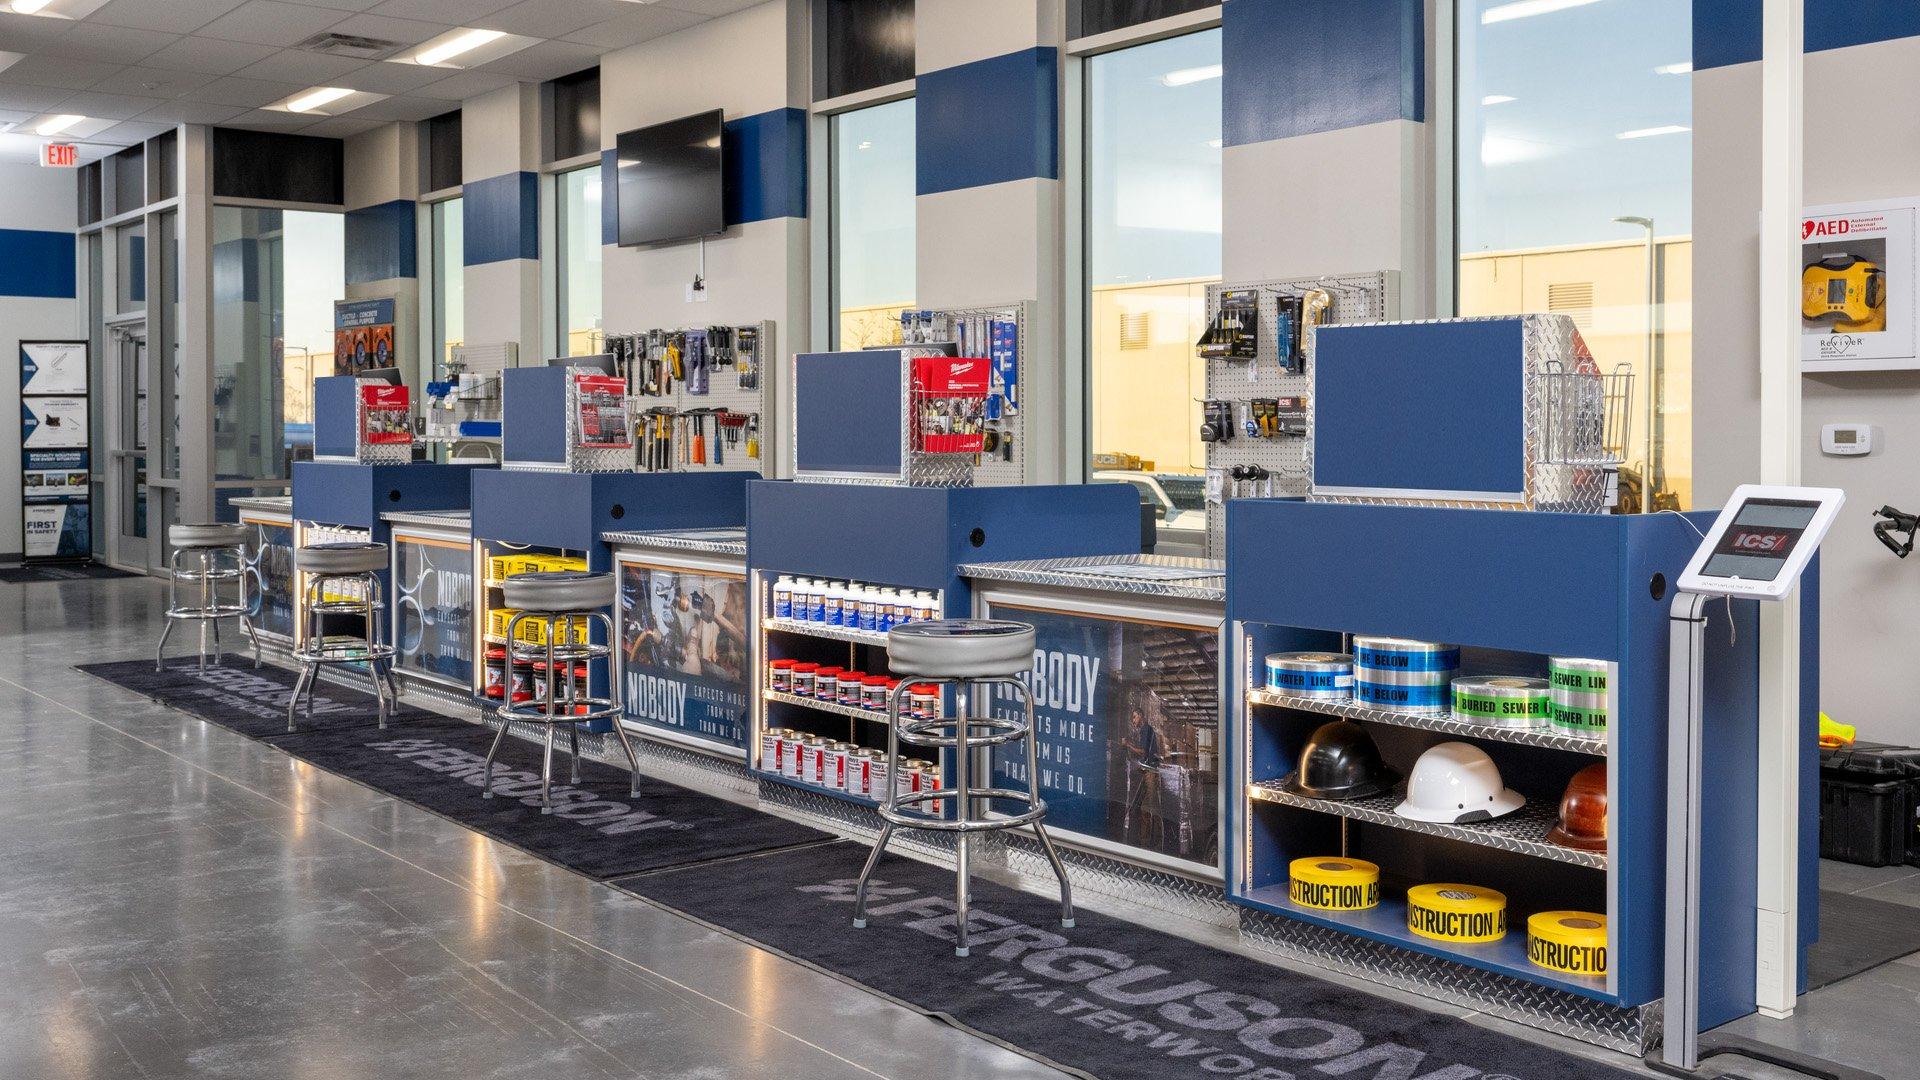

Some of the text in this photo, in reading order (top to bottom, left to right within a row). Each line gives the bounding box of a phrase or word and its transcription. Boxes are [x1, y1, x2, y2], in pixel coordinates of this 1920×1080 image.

[48, 144, 73, 165] EXIT
[1816, 219, 1849, 236] AED
[1850, 216, 1884, 224] Automated
[27, 521, 57, 529] FIRST
[1734, 534, 1777, 549] ICS
[1374, 655, 1408, 667] BELOW
[1277, 673, 1332, 686] WATER LINE
[1554, 672, 1582, 687] SEWER
[627, 671, 687, 726] NOBODY
[694, 685, 746, 707] EXPECTS MORE
[1374, 688, 1408, 701] BELOW
[706, 704, 734, 722] FROM US
[1462, 698, 1539, 713] BURIED SEWER
[1554, 709, 1582, 724] SEWER
[699, 719, 716, 734] THAN
[720, 724, 729, 738] WE
[997, 708, 1094, 743] EXPETS MORE
[1020, 739, 1071, 765] FOM US
[1004, 760, 1086, 796] THA WE DO.
[395, 747, 675, 835] FERGUSON
[866, 896, 1482, 1080] FERGUSON
